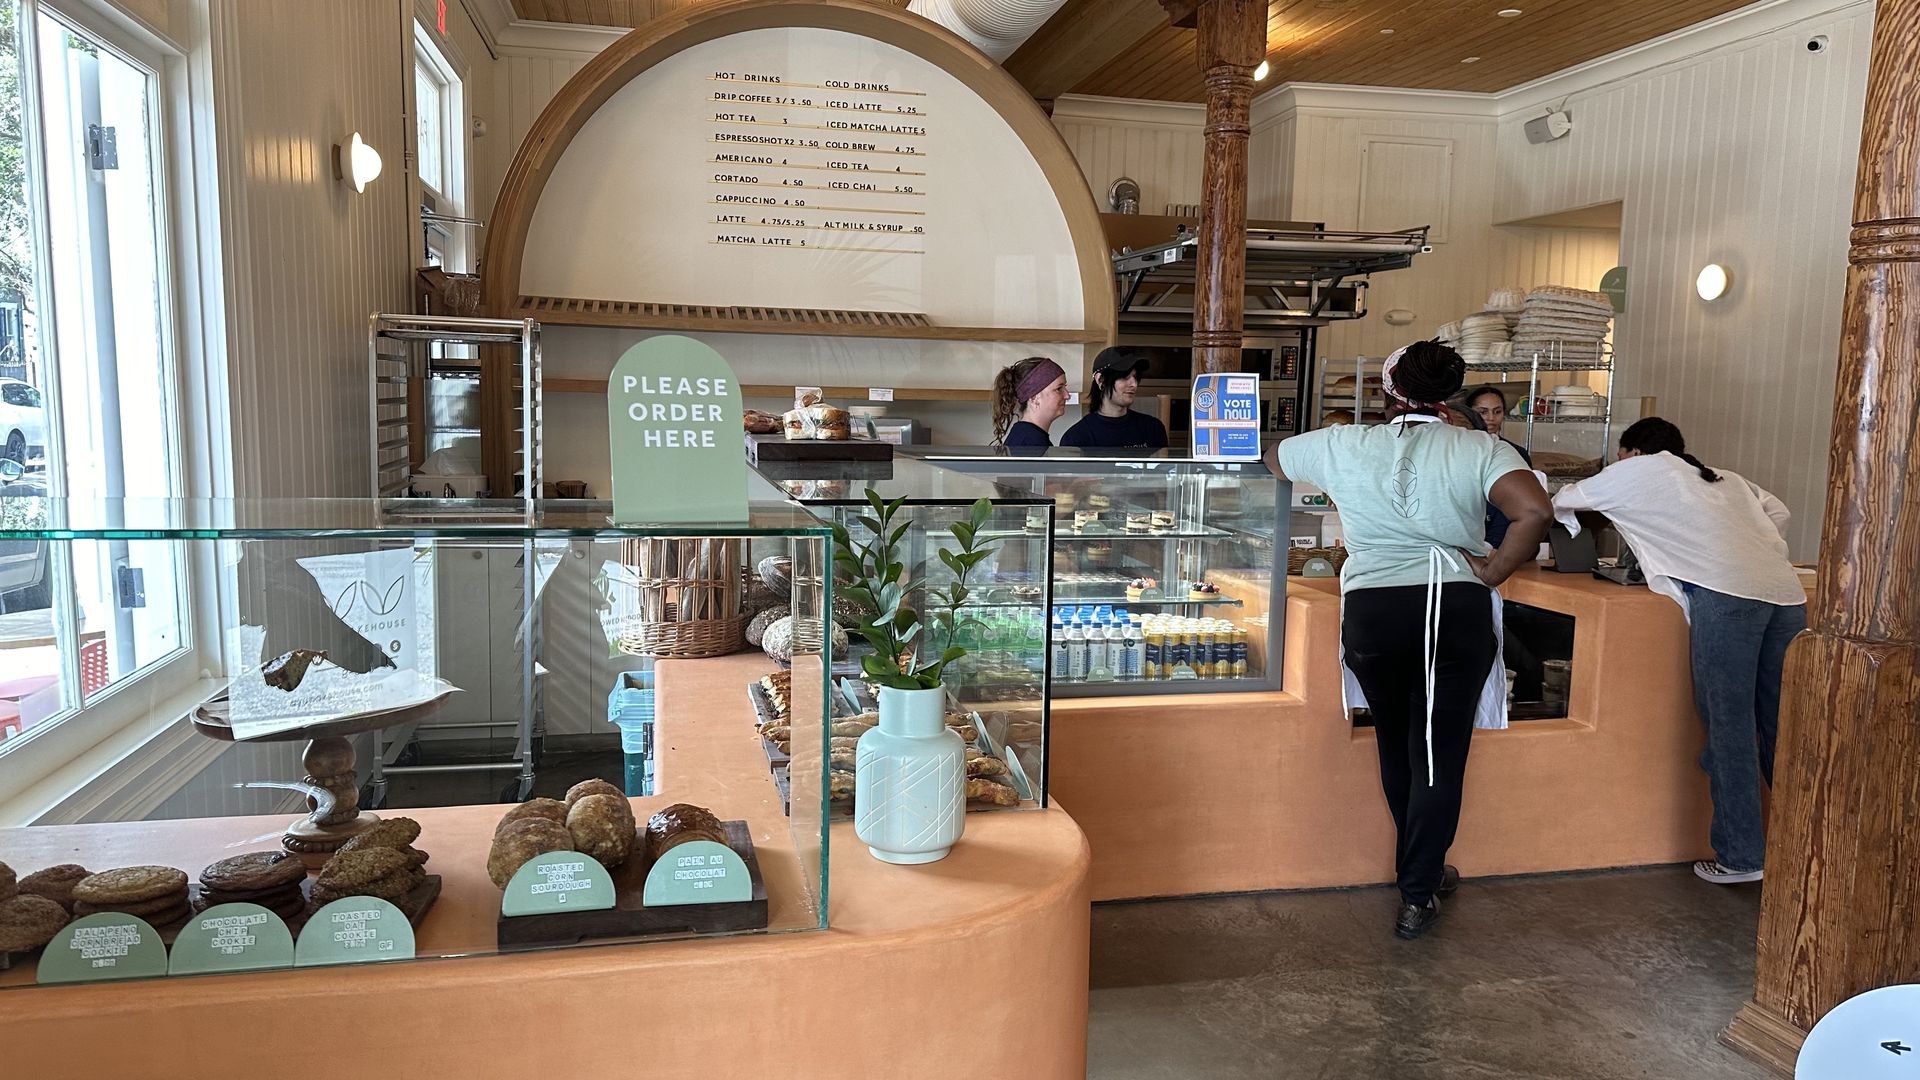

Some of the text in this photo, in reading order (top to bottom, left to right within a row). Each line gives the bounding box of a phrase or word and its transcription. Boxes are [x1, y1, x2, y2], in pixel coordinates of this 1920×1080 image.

[745, 74, 780, 83] DRINKS
[855, 83, 889, 91] DRINKS
[739, 94, 771, 103] COFFEE
[854, 103, 882, 111] LATTE
[851, 123, 887, 131] MATCHA
[891, 126, 918, 134] LATTE
[716, 154, 772, 164] AMERICANO
[715, 174, 758, 183] CORTADO
[716, 195, 776, 204] CAPPUCCINO
[761, 218, 805, 226] 4.75/5.25
[623, 376, 728, 396] PLEASE
[1223, 400, 1251, 408] VOTE
[629, 403, 723, 422] ORDER
[644, 430, 716, 447] HERE
[679, 857, 704, 866] PAIN
[538, 864, 583, 873] ROASTED
[548, 873, 574, 881] CORN
[676, 869, 725, 879] CHOCOLAT
[532, 881, 591, 892] SOURDOUGH
[333, 911, 380, 921] TOASTED
[202, 915, 267, 929] CHOCOLATE
[345, 922, 365, 930] OAT
[75, 924, 137, 938] JALAPENO
[219, 928, 247, 936] CHIP
[335, 930, 376, 940] COOKIE
[71, 935, 140, 948] CORNBREAD
[212, 937, 255, 947] COOKIE
[380, 942, 393, 950] GF
[82, 946, 127, 958] COOKIE
